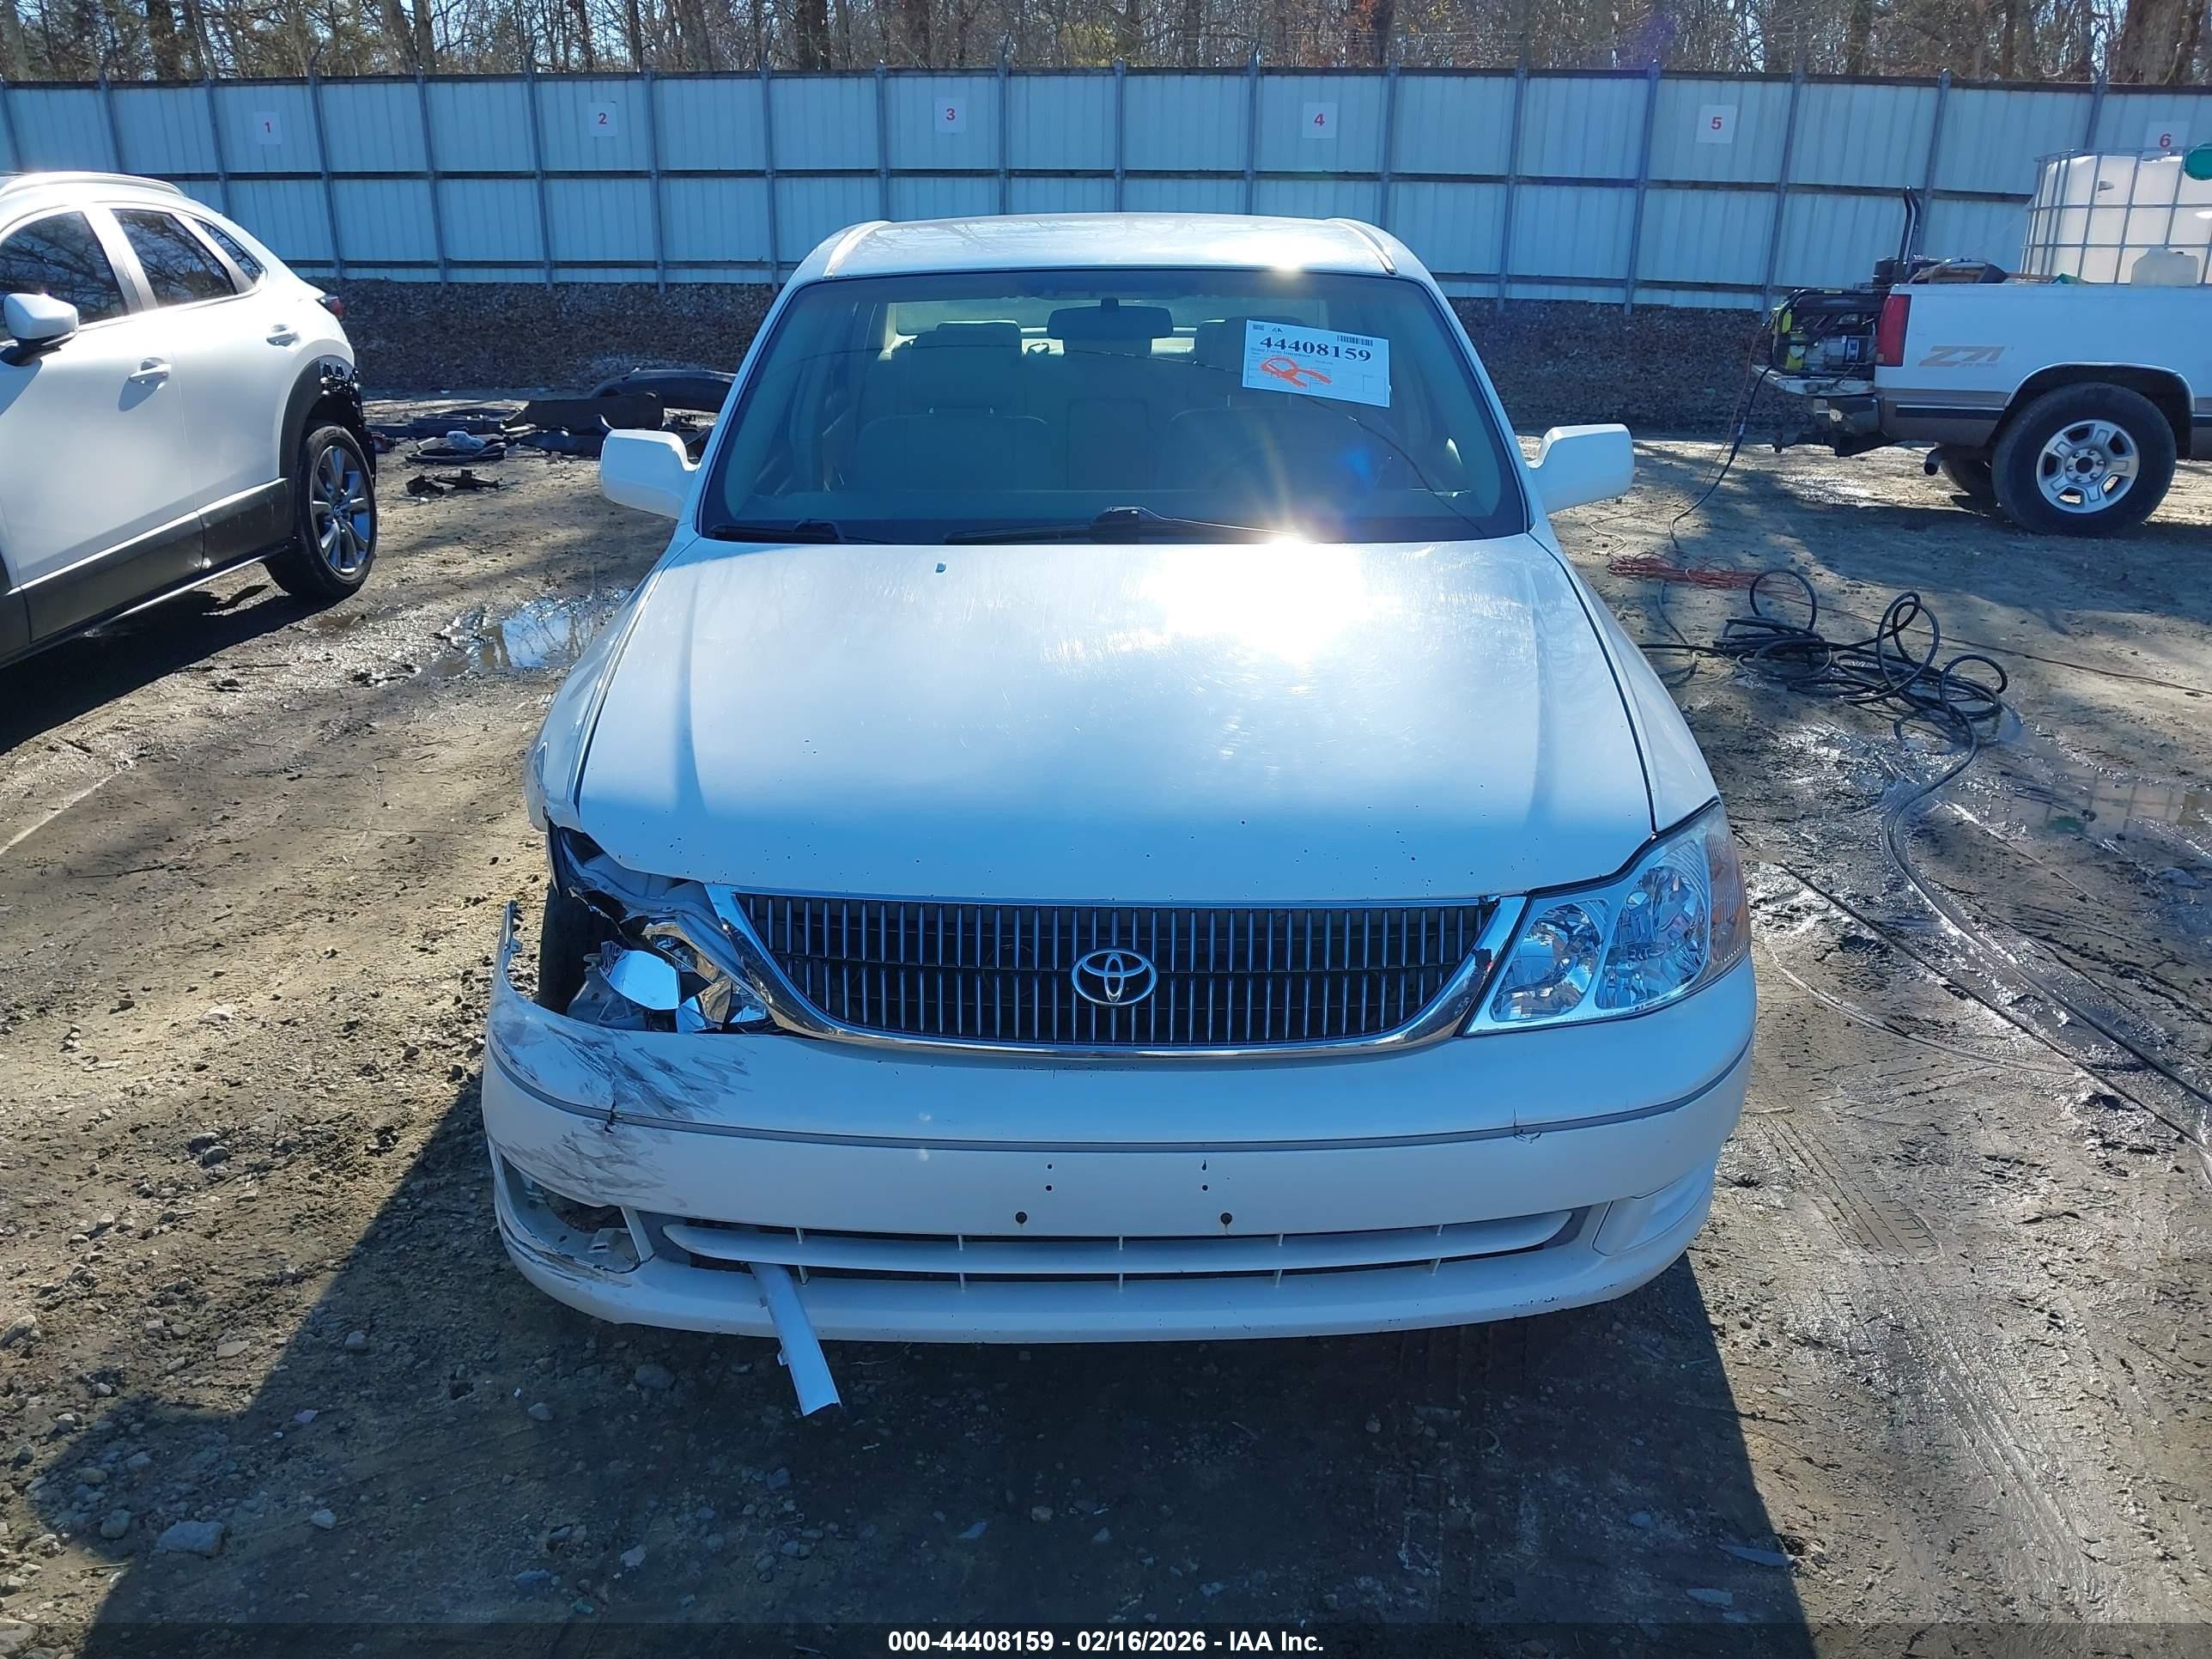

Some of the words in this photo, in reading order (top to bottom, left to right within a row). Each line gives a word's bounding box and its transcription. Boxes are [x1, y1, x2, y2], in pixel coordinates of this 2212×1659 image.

[598, 112, 607, 125] 2
[946, 108, 956, 120] 3
[1314, 113, 1324, 126] 4
[264, 122, 271, 133] 1
[1711, 117, 1723, 130] 5
[2159, 133, 2172, 148] 6
[1260, 336, 1372, 362] 44408159
[1917, 345, 2007, 367] Z71
